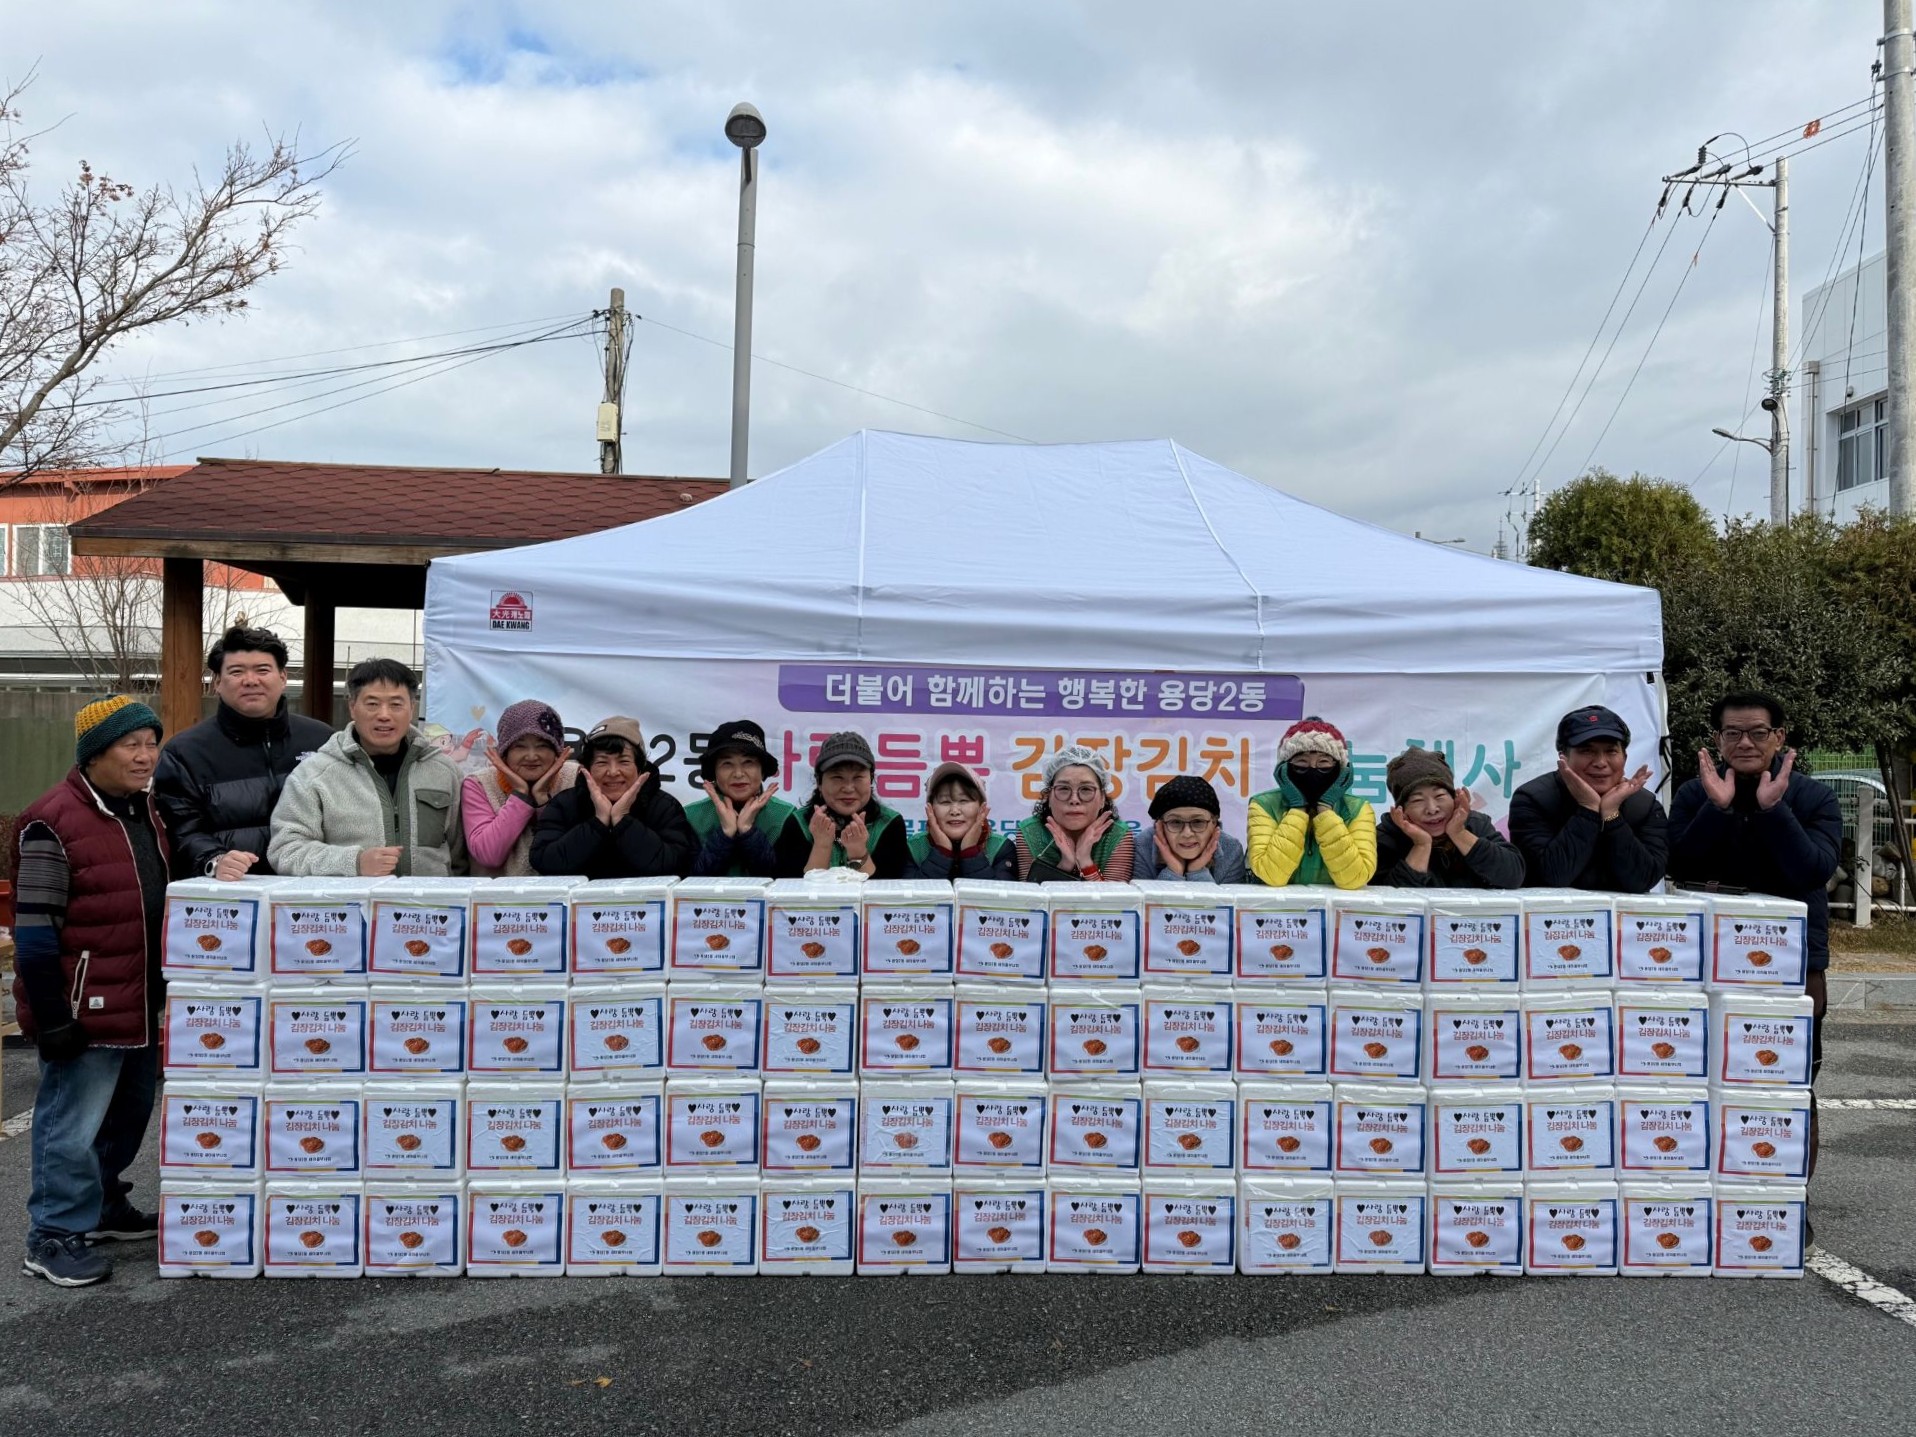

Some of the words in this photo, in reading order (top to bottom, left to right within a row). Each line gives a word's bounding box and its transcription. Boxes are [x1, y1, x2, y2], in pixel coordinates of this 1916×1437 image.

[492, 620, 505, 629] DAE
[506, 620, 530, 630] KWANG
[825, 673, 914, 707] 더불어
[927, 674, 1046, 709] 함께하는
[1058, 677, 1148, 711] 행복한
[1158, 680, 1266, 712] 용당2동
[194, 906, 212, 917] 사랑
[601, 910, 620, 921] 사랑
[402, 911, 421, 923] 사랑
[797, 915, 814, 925] 사랑
[987, 915, 1005, 926] 사랑
[1173, 913, 1191, 923] 사랑
[184, 917, 218, 929] 김장김치
[221, 919, 239, 930] 나눔
[591, 922, 626, 933] 김장김치
[628, 921, 646, 932] 나눔
[1363, 920, 1381, 930] 사랑
[1552, 918, 1570, 928] 사랑
[392, 923, 427, 935] 김장김치
[429, 925, 448, 937] 나눔
[787, 927, 820, 937] 김장김치
[822, 927, 840, 937] 나눔
[978, 926, 1010, 937] 김장김치
[1012, 928, 1030, 939] 나눔
[1163, 924, 1196, 934] 김장김치
[1198, 925, 1216, 935] 나눔
[1743, 923, 1762, 934] 사랑
[1354, 930, 1387, 942] 김장김치
[1389, 933, 1407, 944] 나눔
[1543, 929, 1575, 940] 김장김치
[1577, 929, 1594, 939] 나눔
[1733, 935, 1767, 946] 김장김치
[1770, 936, 1788, 946] 나눔
[196, 1005, 215, 1015] 사랑
[500, 1009, 518, 1019] 사랑
[699, 1007, 717, 1017] 사랑
[891, 1007, 909, 1017] 사랑
[301, 1010, 319, 1021] 사랑
[1079, 1013, 1096, 1023] 사랑
[1265, 1012, 1283, 1023] 사랑
[1647, 1015, 1664, 1025] 사랑
[186, 1017, 221, 1028] 김장김치
[223, 1017, 242, 1028] 나눔
[290, 1022, 325, 1033] 김장김치
[328, 1022, 346, 1033] 나눔
[489, 1021, 524, 1031] 김장김치
[526, 1021, 545, 1032] 나눔
[689, 1018, 723, 1029] 김장김치
[725, 1019, 743, 1030] 나눔
[882, 1019, 915, 1029] 김장김치
[917, 1019, 935, 1028] 나눔
[1461, 1019, 1479, 1028] 사랑
[1069, 1024, 1102, 1034] 김장김치
[1104, 1024, 1121, 1034] 나눔
[1255, 1023, 1289, 1034] 김장김치
[1291, 1024, 1308, 1035] 나눔
[1637, 1026, 1670, 1037] 김장김치
[1672, 1027, 1690, 1037] 나눔
[1452, 1030, 1485, 1040] 김장김치
[1487, 1030, 1504, 1040] 나눔
[193, 1104, 211, 1115] 사랑
[392, 1107, 411, 1117] 사랑
[597, 1106, 616, 1116] 사랑
[793, 1107, 811, 1117] 사랑
[985, 1104, 1003, 1114] 사랑
[1174, 1107, 1191, 1117] 사랑
[1555, 1109, 1572, 1119] 사랑
[975, 1115, 1008, 1125] 김장김치
[1010, 1116, 1028, 1126] 나눔
[1366, 1111, 1383, 1121] 사랑
[1749, 1115, 1767, 1125] 사랑
[182, 1116, 217, 1127] 김장김치
[219, 1117, 238, 1127] 나눔
[382, 1118, 416, 1129] 김장김치
[419, 1119, 437, 1129] 나눔
[587, 1117, 621, 1128] 김장김치
[624, 1117, 642, 1127] 나눔
[783, 1119, 817, 1129] 김장김치
[819, 1119, 836, 1129] 나눔
[1164, 1118, 1197, 1128] 김장김치
[1199, 1119, 1217, 1129] 나눔
[1546, 1120, 1578, 1130] 김장김치
[1580, 1120, 1597, 1129] 나눔
[1356, 1122, 1389, 1132] 김장김치
[1391, 1123, 1408, 1133] 나눔
[1739, 1125, 1773, 1137] 김장김치
[1775, 1128, 1792, 1138] 나눔
[295, 1203, 314, 1214] 사랑
[499, 1202, 517, 1212] 사랑
[694, 1203, 712, 1213] 사랑
[888, 1203, 906, 1213] 사랑
[1079, 1201, 1097, 1212] 사랑
[1365, 1203, 1382, 1213] 사랑
[1462, 1205, 1480, 1215] 사랑
[1652, 1206, 1669, 1216] 사랑
[285, 1215, 320, 1226] 김장김치
[322, 1215, 340, 1226] 나눔
[489, 1214, 523, 1224] 김장김치
[526, 1214, 544, 1224] 나눔
[684, 1215, 718, 1225] 김장김치
[720, 1215, 738, 1225] 나눔
[878, 1214, 912, 1224] 김장김치
[914, 1214, 932, 1224] 나눔
[1070, 1212, 1103, 1223] 김장김치
[1105, 1213, 1123, 1224] 나눔
[1355, 1214, 1388, 1224] 김장김치
[1390, 1215, 1407, 1224] 나눔
[1452, 1216, 1485, 1226] 김장김치
[1487, 1217, 1505, 1226] 나눔
[1643, 1217, 1675, 1227] 김장김치
[1677, 1218, 1694, 1227] 나눔
